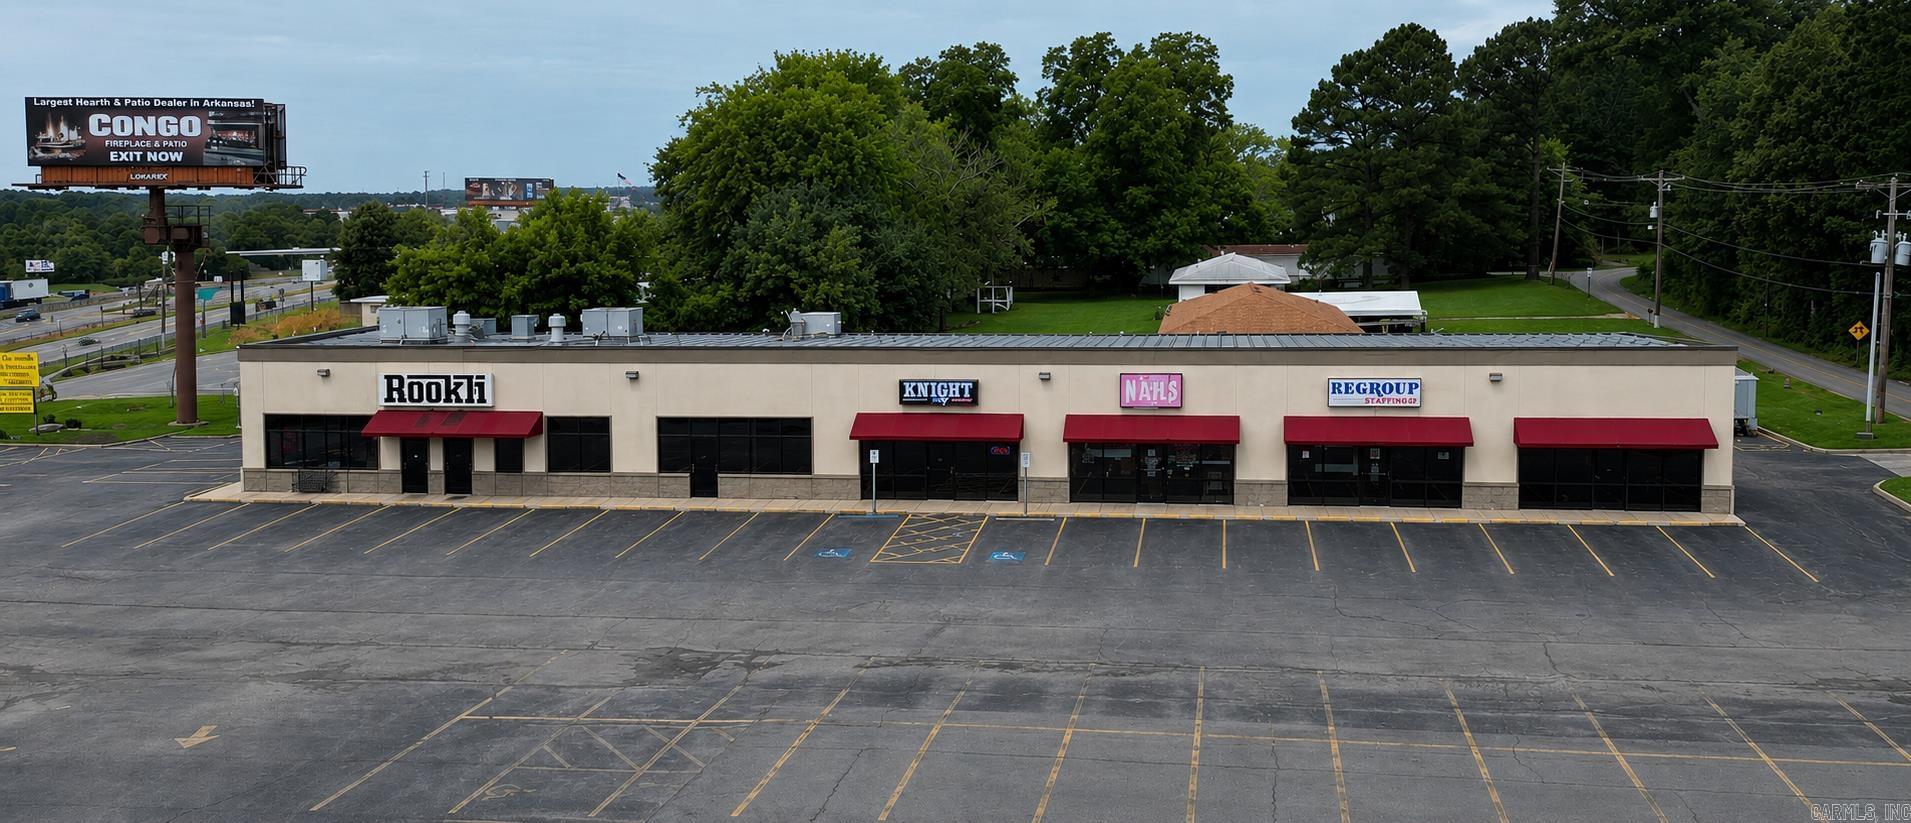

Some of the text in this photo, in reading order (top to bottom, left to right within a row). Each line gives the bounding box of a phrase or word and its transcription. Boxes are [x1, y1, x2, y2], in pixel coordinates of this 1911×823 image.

[33, 98, 255, 108] Largest Hearth & Patio Dealer in Arkansas!
[88, 113, 201, 137] CONGO
[105, 140, 187, 148] FIREPLACE & PATIO
[110, 151, 183, 162] EXIT NOW
[903, 382, 973, 398] KNIGHT
[1331, 382, 1419, 397] REGROUP
